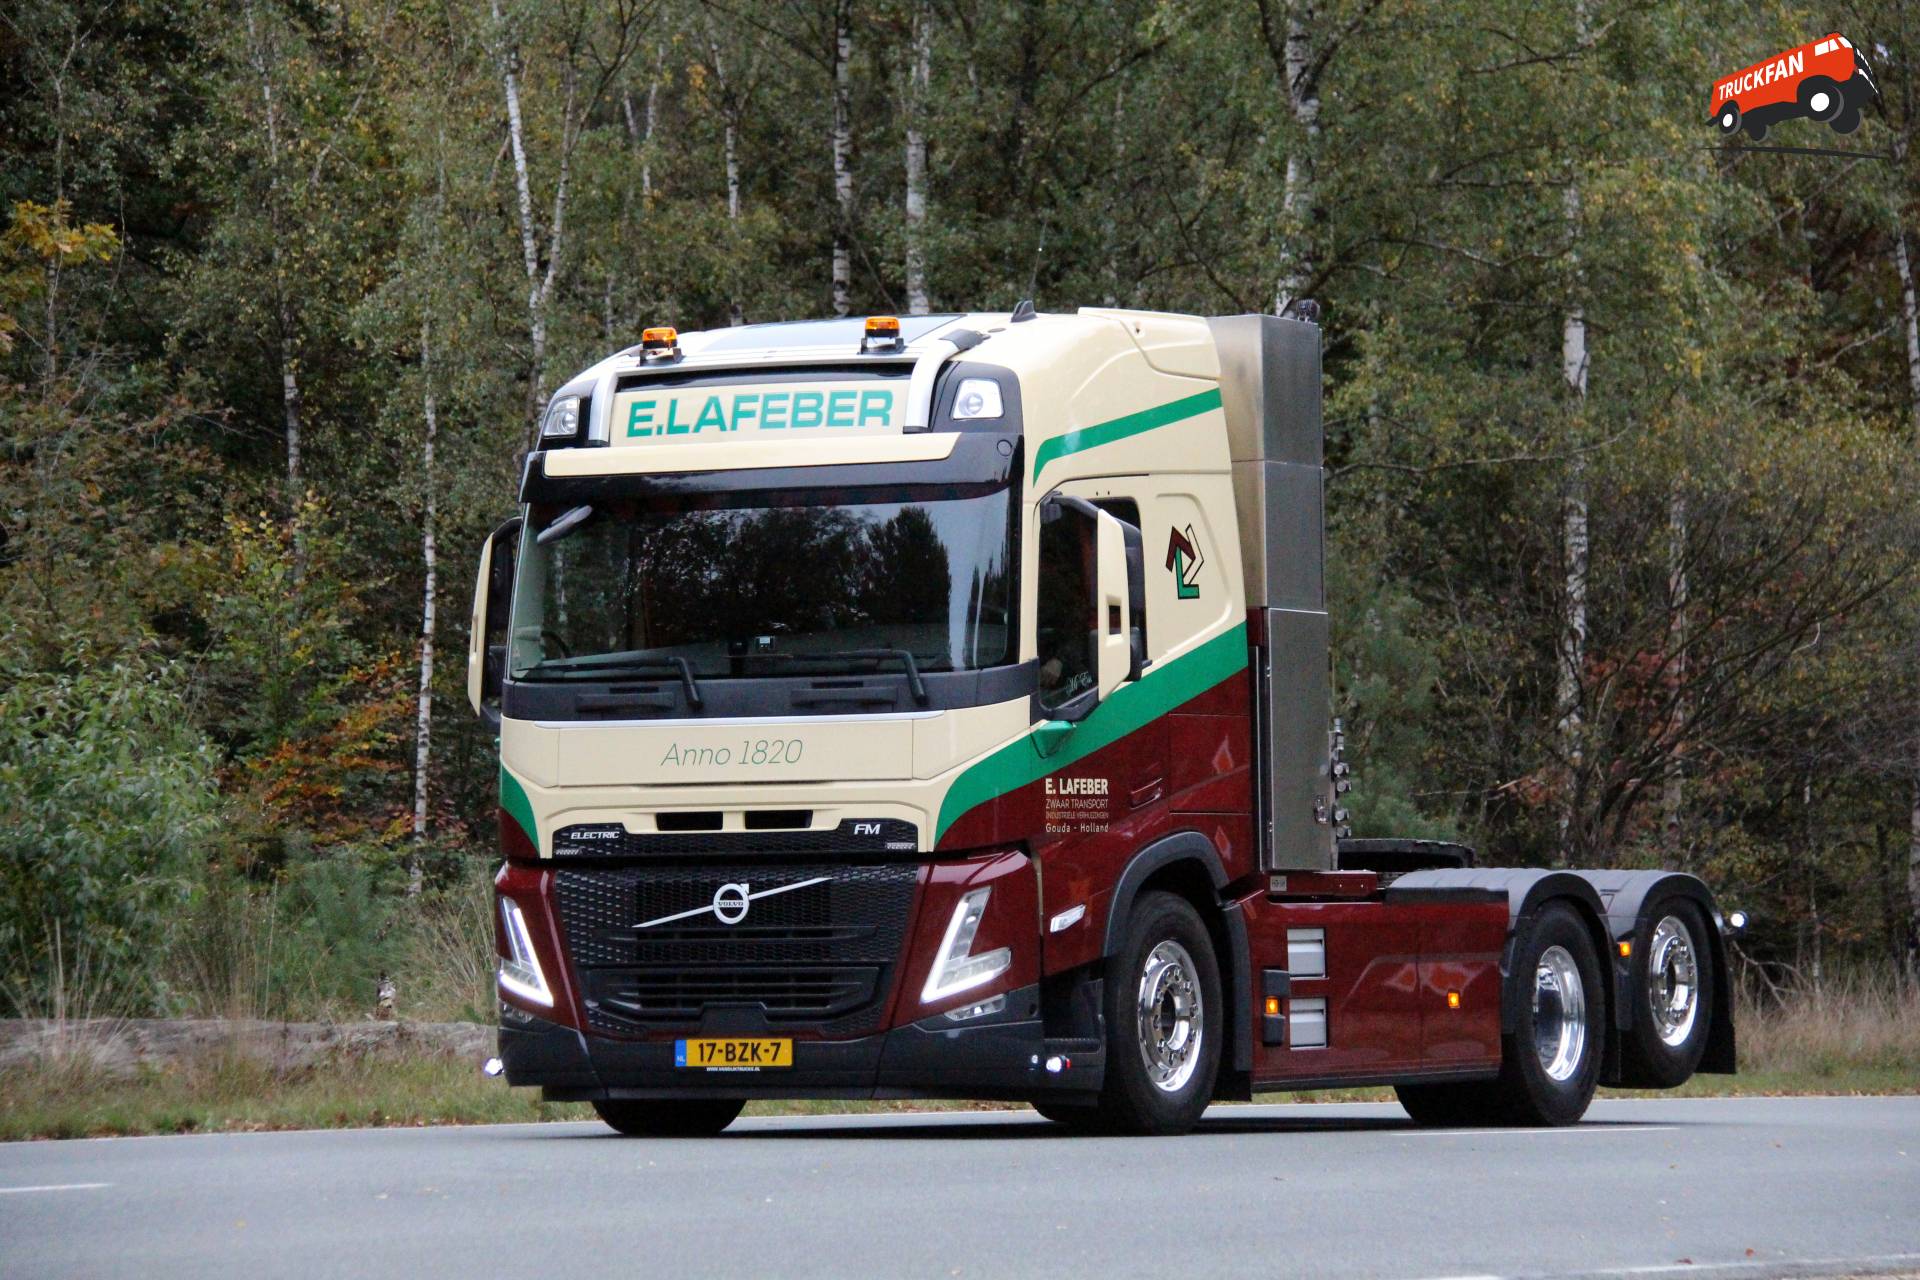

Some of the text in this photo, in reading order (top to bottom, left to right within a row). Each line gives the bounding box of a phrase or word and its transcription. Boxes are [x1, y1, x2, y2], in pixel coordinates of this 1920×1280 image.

[660, 739, 803, 766] Anno 1820
[1045, 778, 1108, 794] E. LAFEBER
[1045, 798, 1108, 809] ZWAAR TRANSPORT
[853, 823, 881, 835] FM
[1045, 823, 1071, 833] Gouda
[1080, 823, 1108, 833] Holland
[570, 831, 620, 839] ELECTRIC
[698, 1042, 781, 1062] 17-BZK-7
